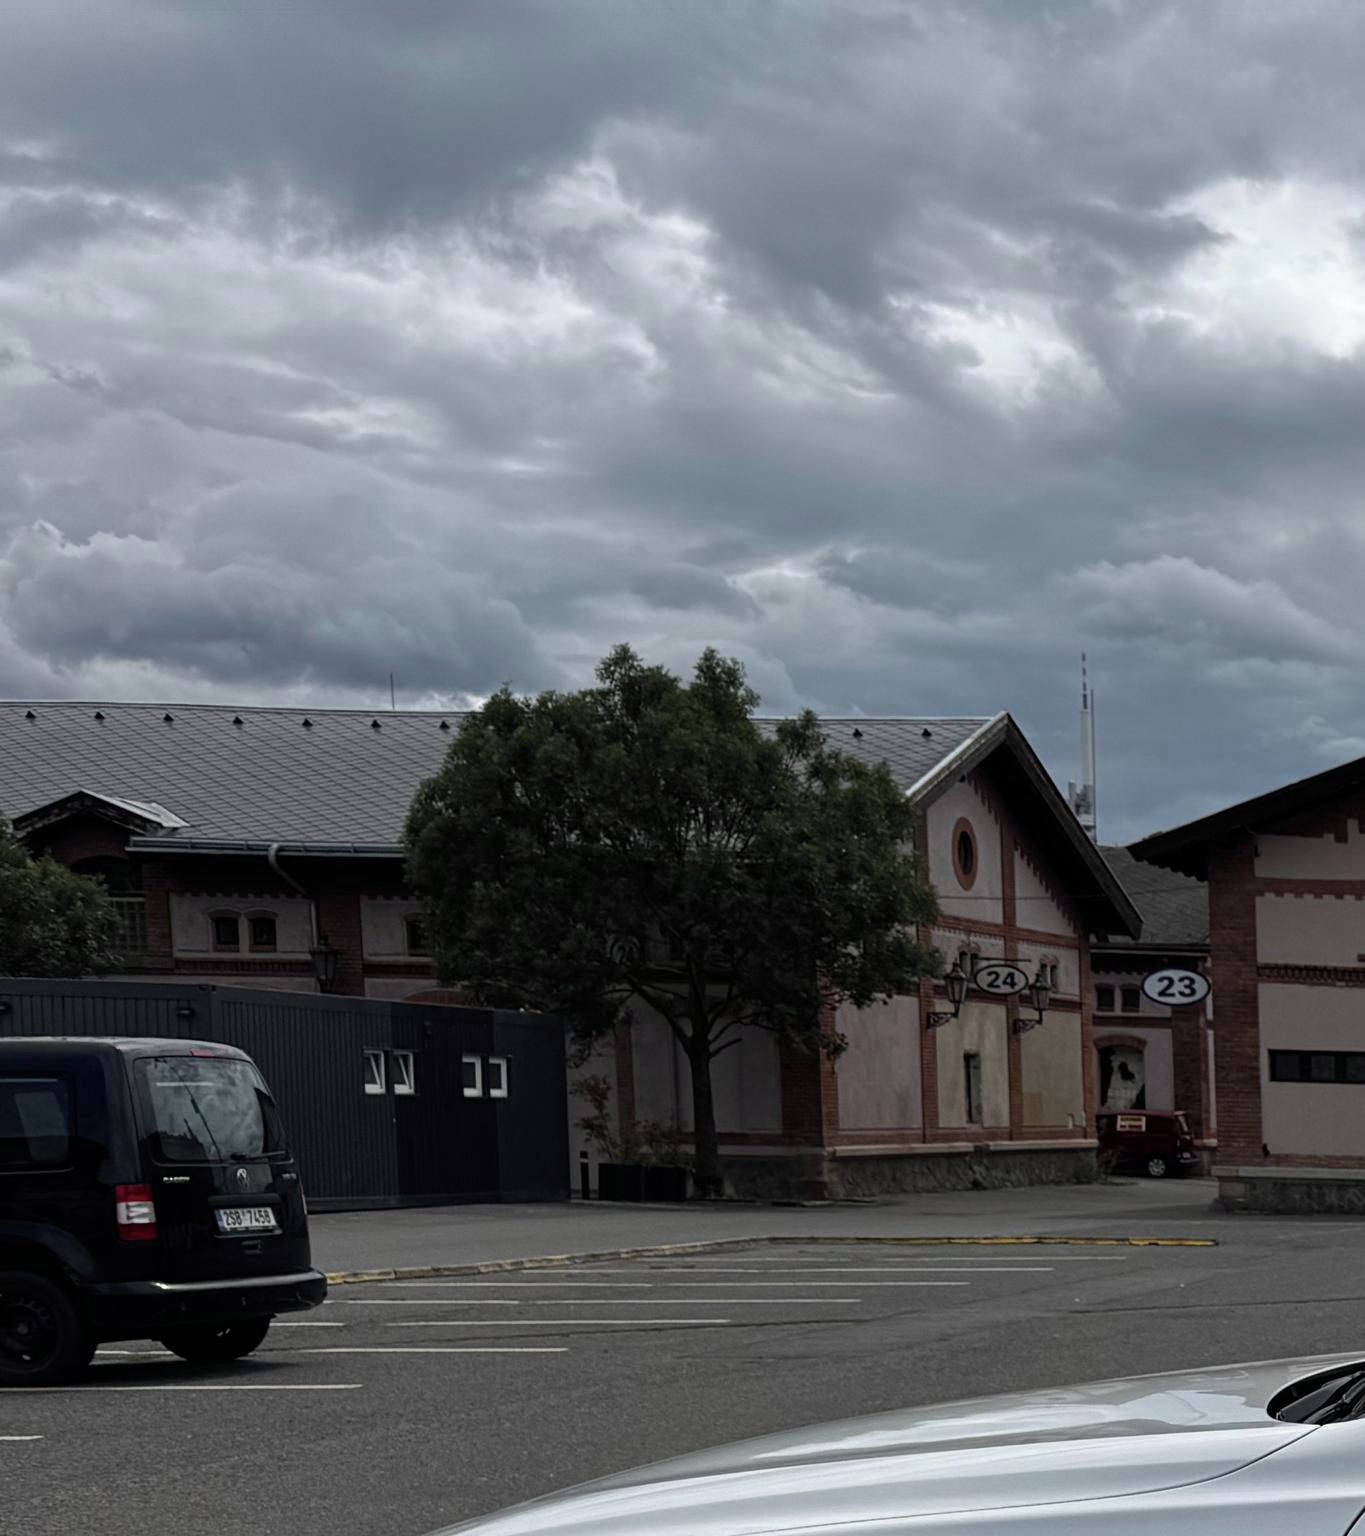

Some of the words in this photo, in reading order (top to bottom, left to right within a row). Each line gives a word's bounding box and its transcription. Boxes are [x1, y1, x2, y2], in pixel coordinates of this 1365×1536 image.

[986, 971, 1017, 989] 24
[1157, 976, 1196, 997] 23
[223, 1209, 242, 1226] 2SB
